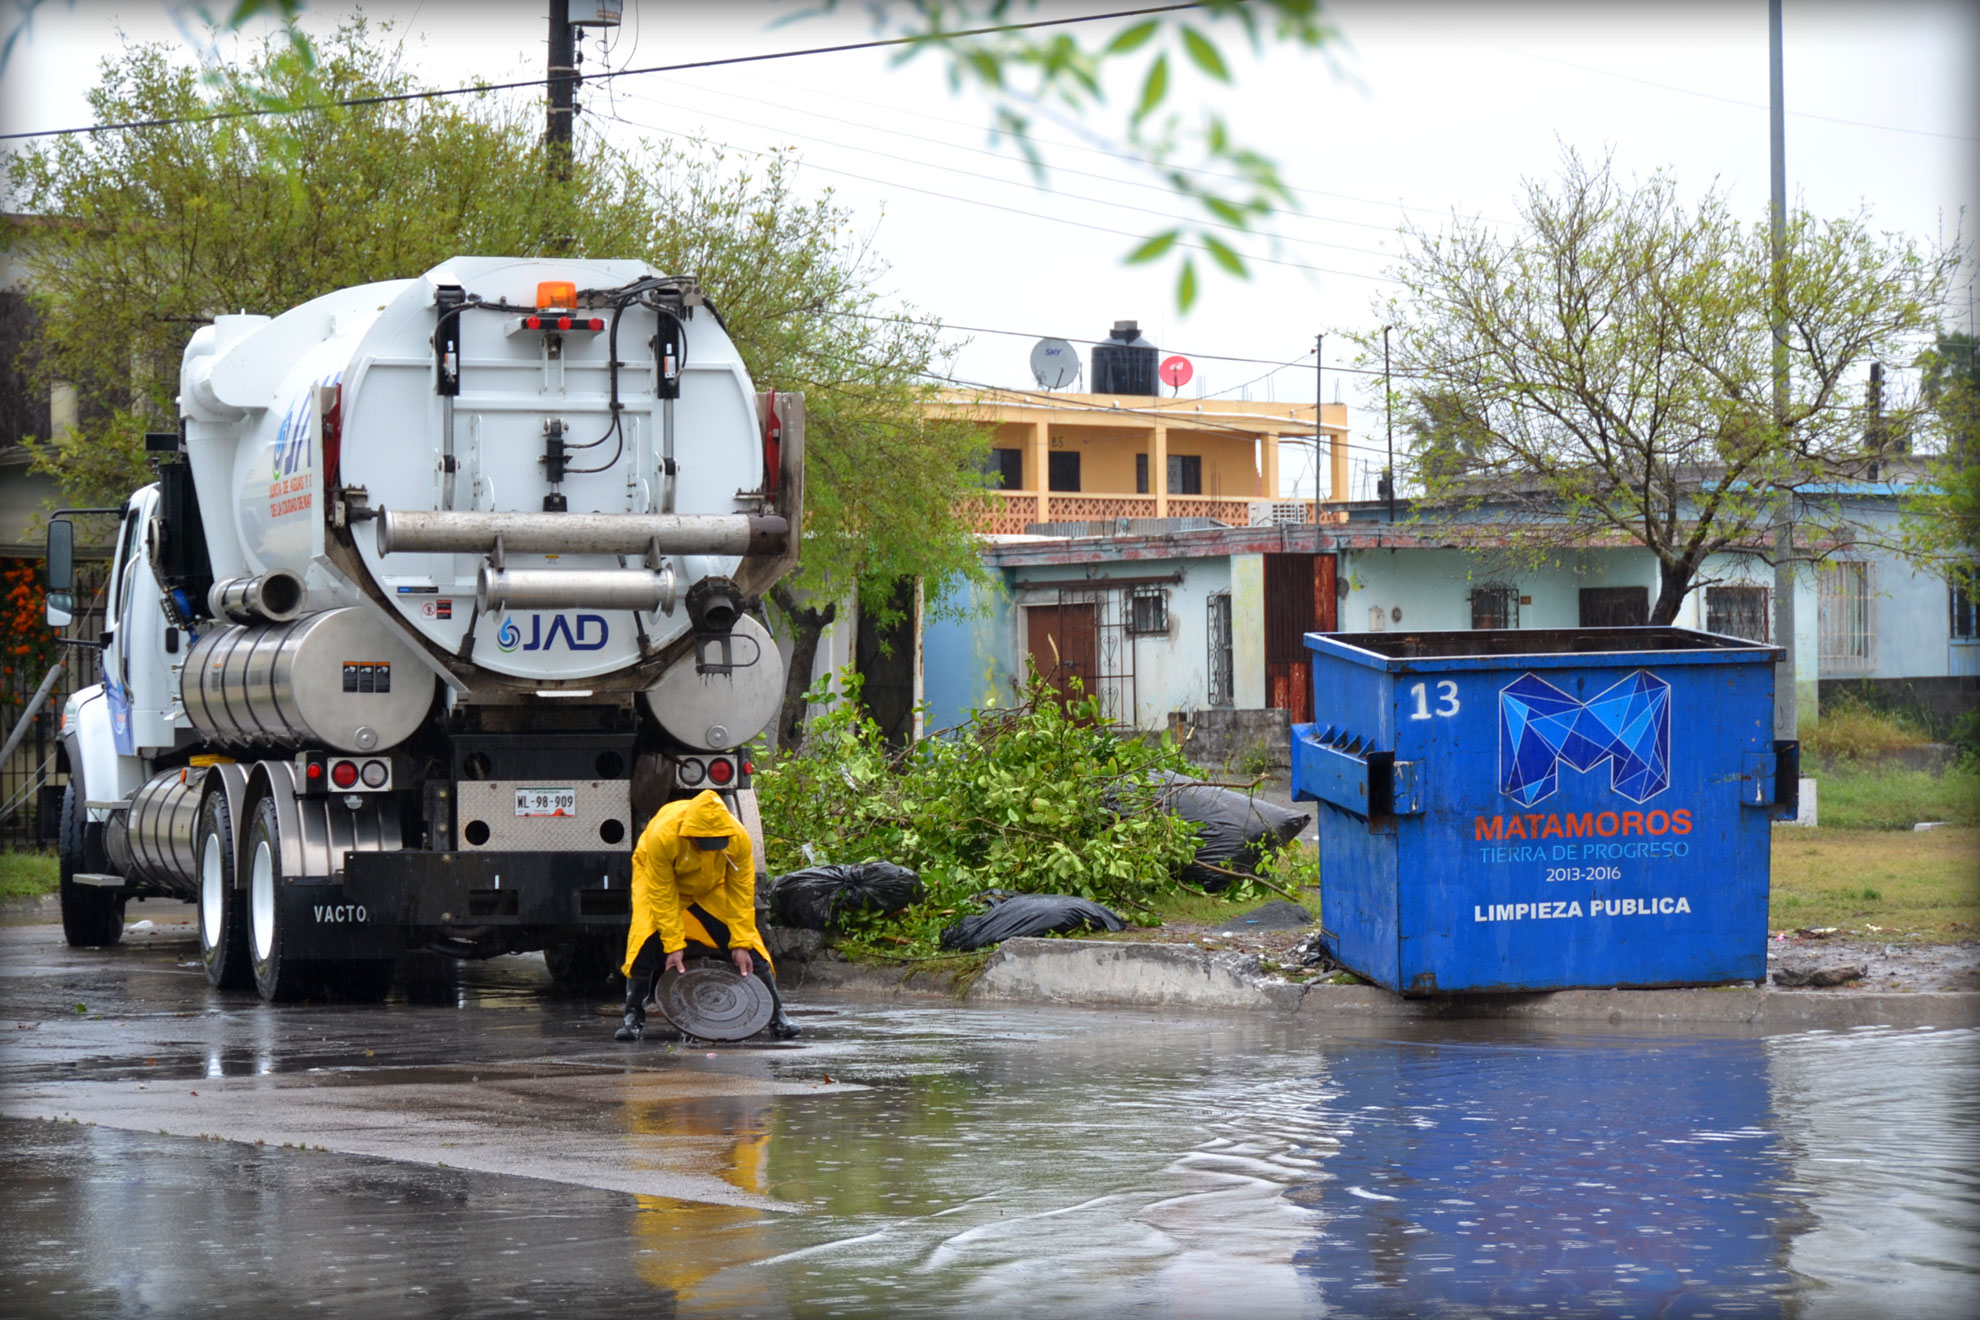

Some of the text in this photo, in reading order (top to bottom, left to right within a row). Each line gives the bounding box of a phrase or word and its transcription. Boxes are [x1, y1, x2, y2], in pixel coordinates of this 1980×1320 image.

[523, 614, 609, 651] JAD
[1410, 680, 1461, 720] 13
[517, 795, 573, 808] WL-98-909
[1475, 809, 1693, 841] MATAMOROS
[1479, 841, 1689, 864] TIERRA DE PROGRESO
[1545, 866, 1621, 882] 2013-2016
[313, 904, 369, 923] VACTO
[1474, 896, 1691, 922] LIMPIEZA PUBLICA
